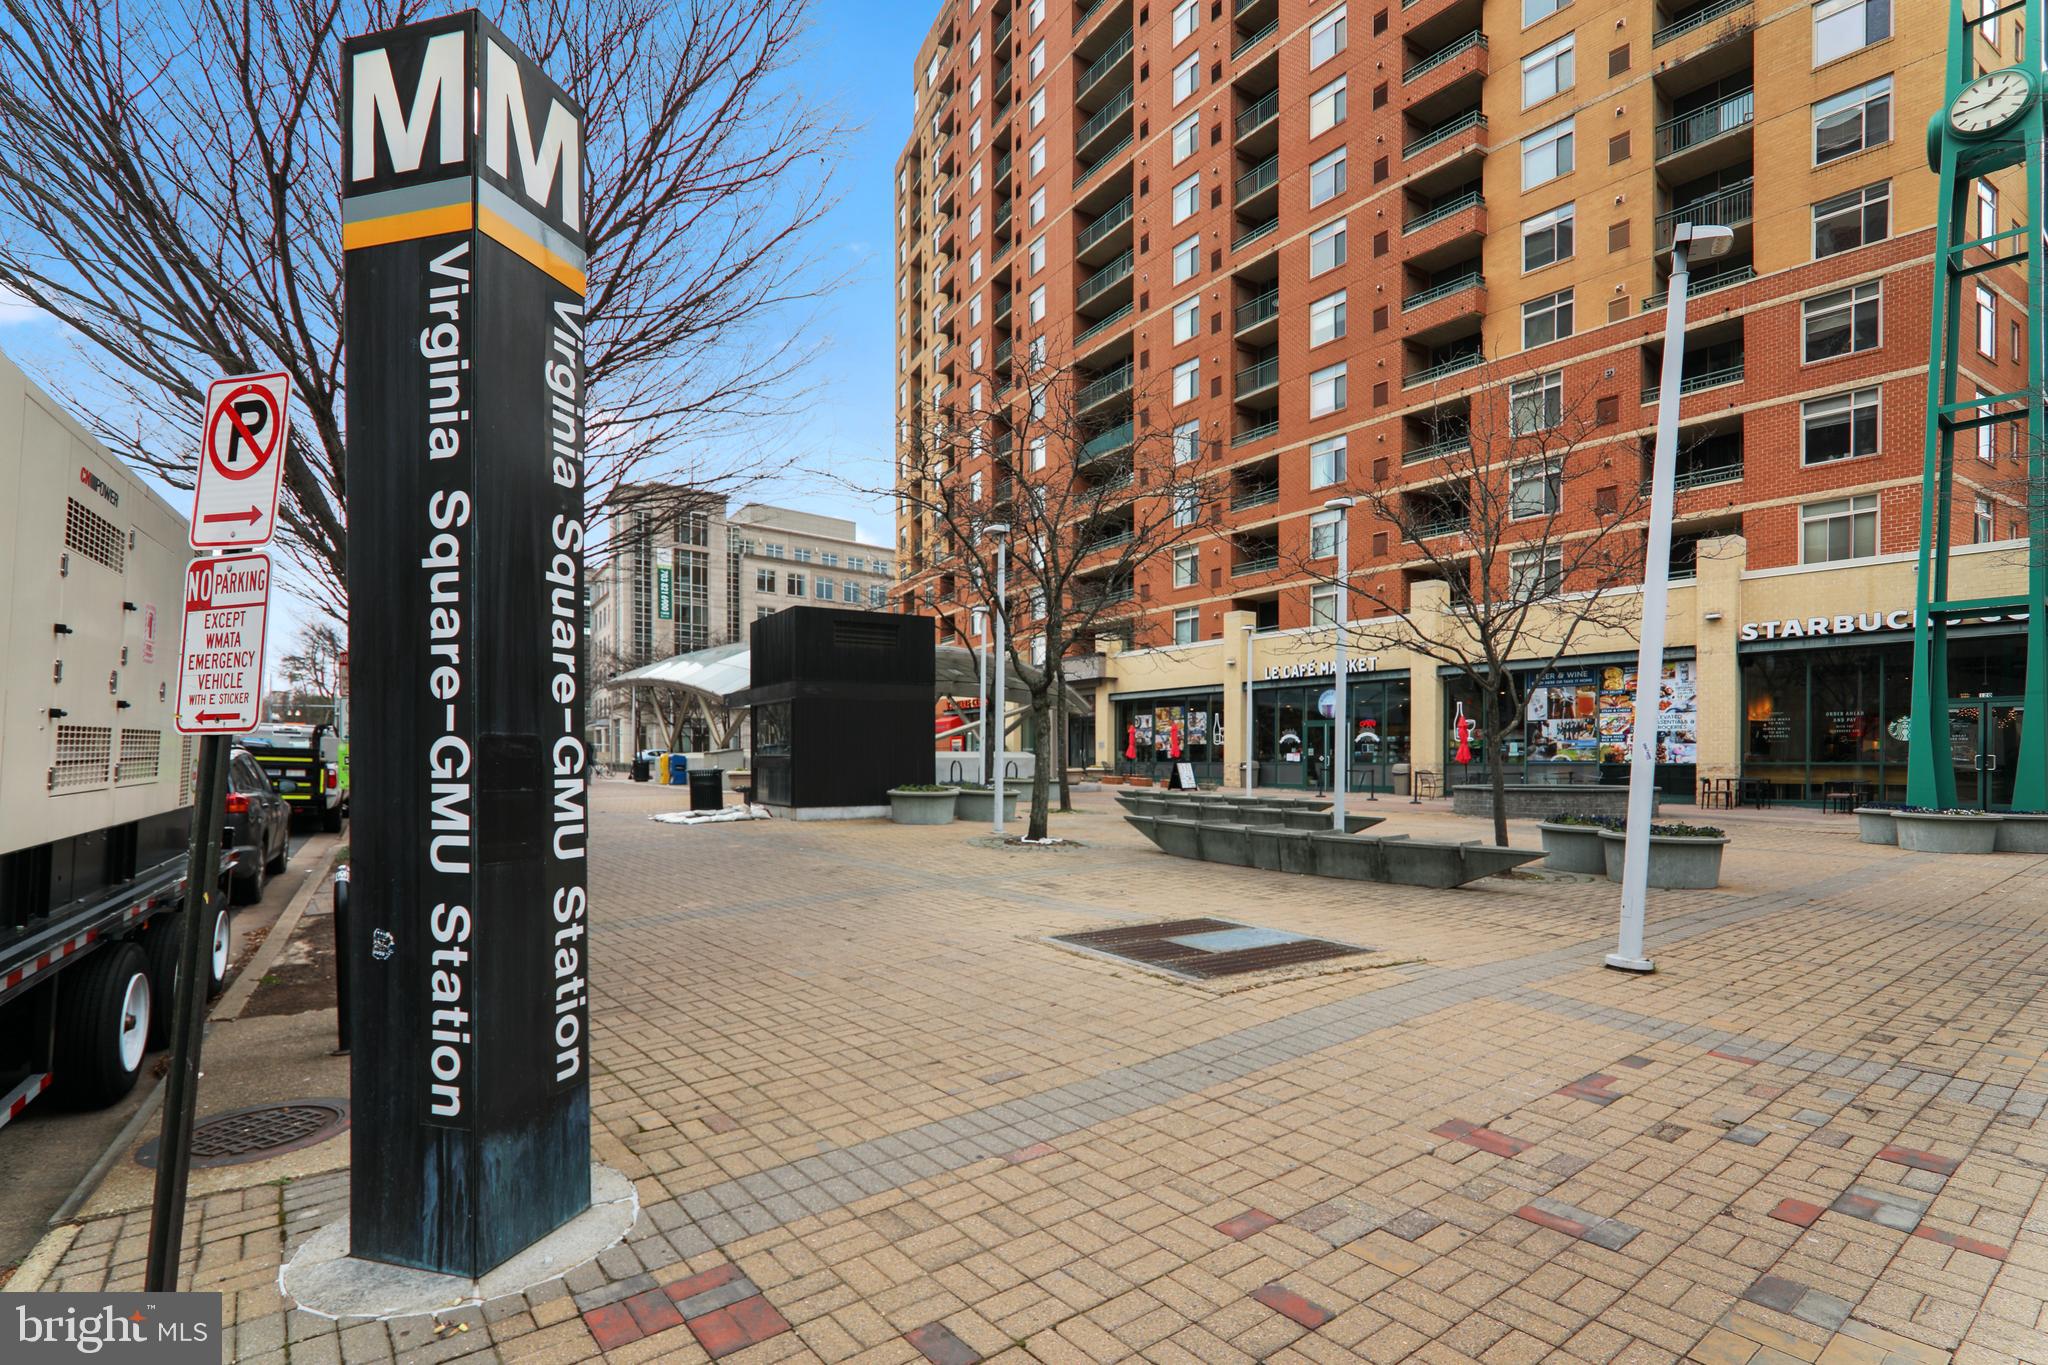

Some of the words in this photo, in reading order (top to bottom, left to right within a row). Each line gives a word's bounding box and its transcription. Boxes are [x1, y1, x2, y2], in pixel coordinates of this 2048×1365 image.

[353, 30, 464, 181] M
[486, 36, 579, 232] M
[419, 241, 469, 460] Virginia
[544, 299, 583, 489] Virginia
[187, 569, 212, 602] NO
[214, 569, 266, 595] PARKING
[204, 611, 246, 630] EXCEPT
[1741, 610, 1961, 640] STARBUC
[206, 632, 241, 649] WMATA
[188, 651, 255, 670] EMERGENCY
[1264, 666, 1280, 680] LE
[1283, 660, 1316, 678] CAFÉ
[1566, 670, 1589, 678] WINE
[198, 672, 243, 690] VEHICLE
[189, 694, 206, 705] WITH
[219, 692, 249, 704] STICKER
[553, 886, 586, 1082] Station
[430, 903, 471, 1116] Station
